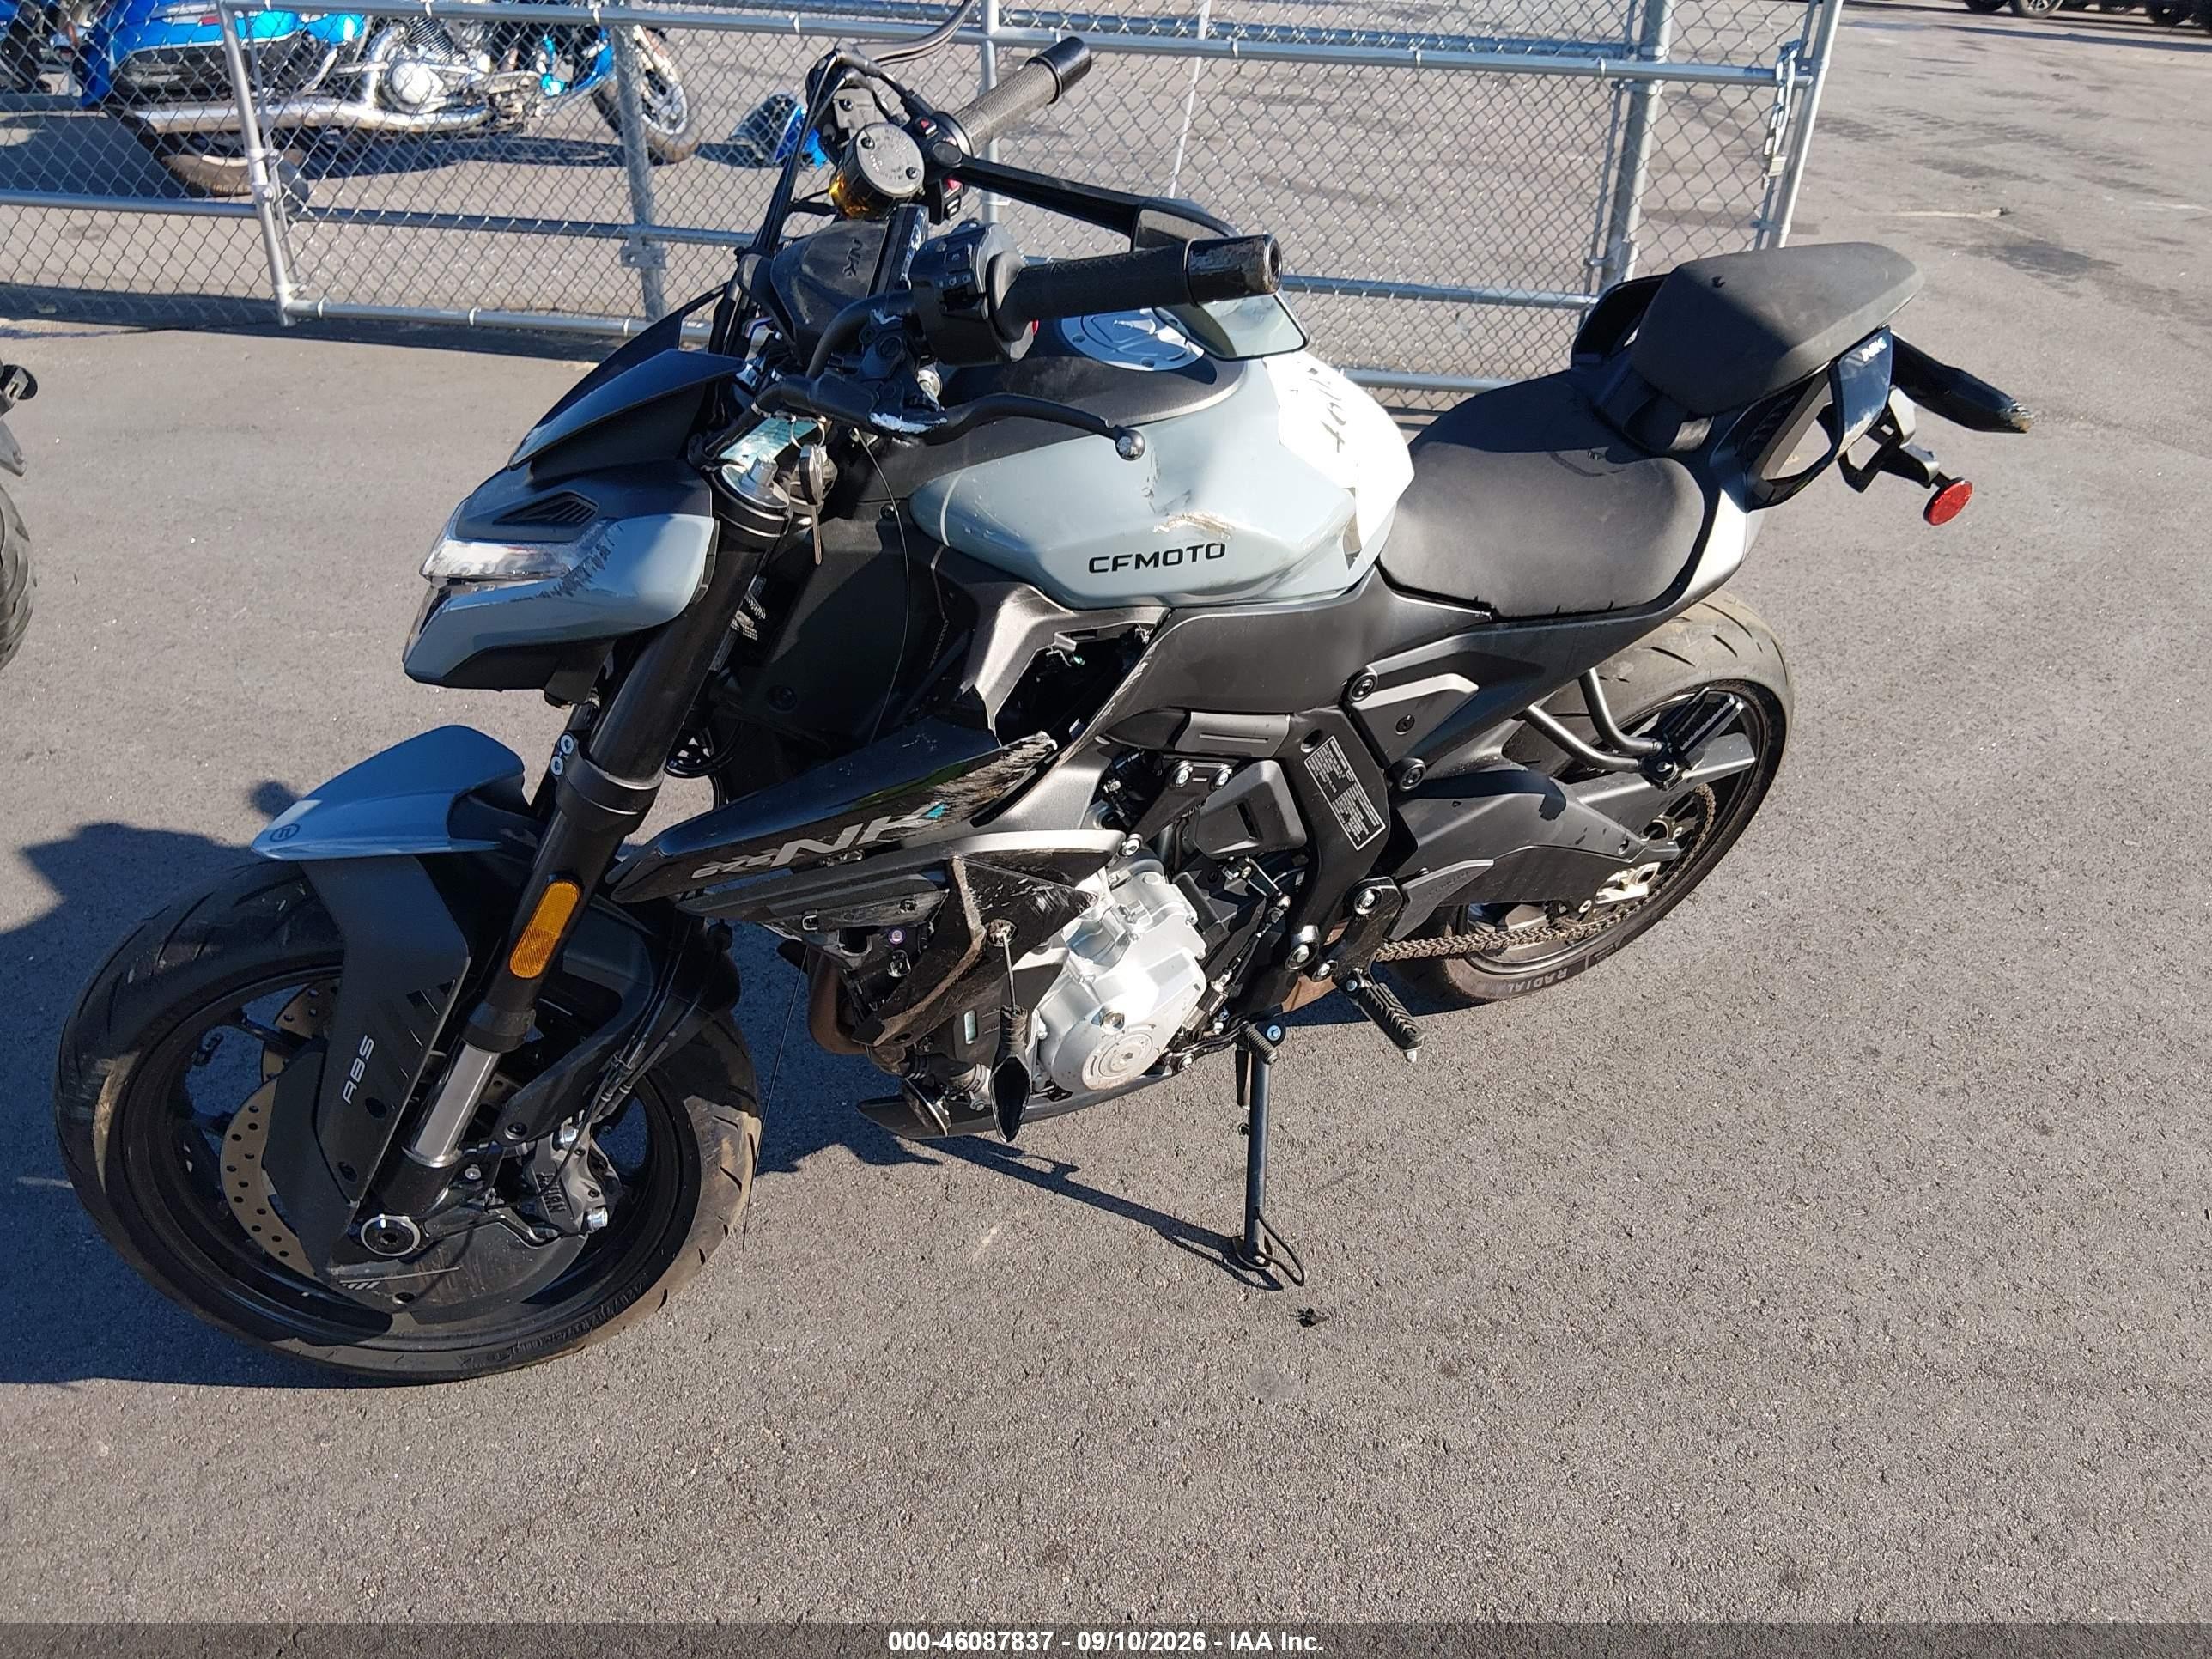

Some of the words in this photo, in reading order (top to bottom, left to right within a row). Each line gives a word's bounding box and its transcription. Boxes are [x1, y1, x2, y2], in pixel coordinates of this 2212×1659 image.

[1088, 542, 1226, 574] CFMOTO
[1508, 967, 1568, 994] RADIAL
[342, 1033, 375, 1105] ABS
